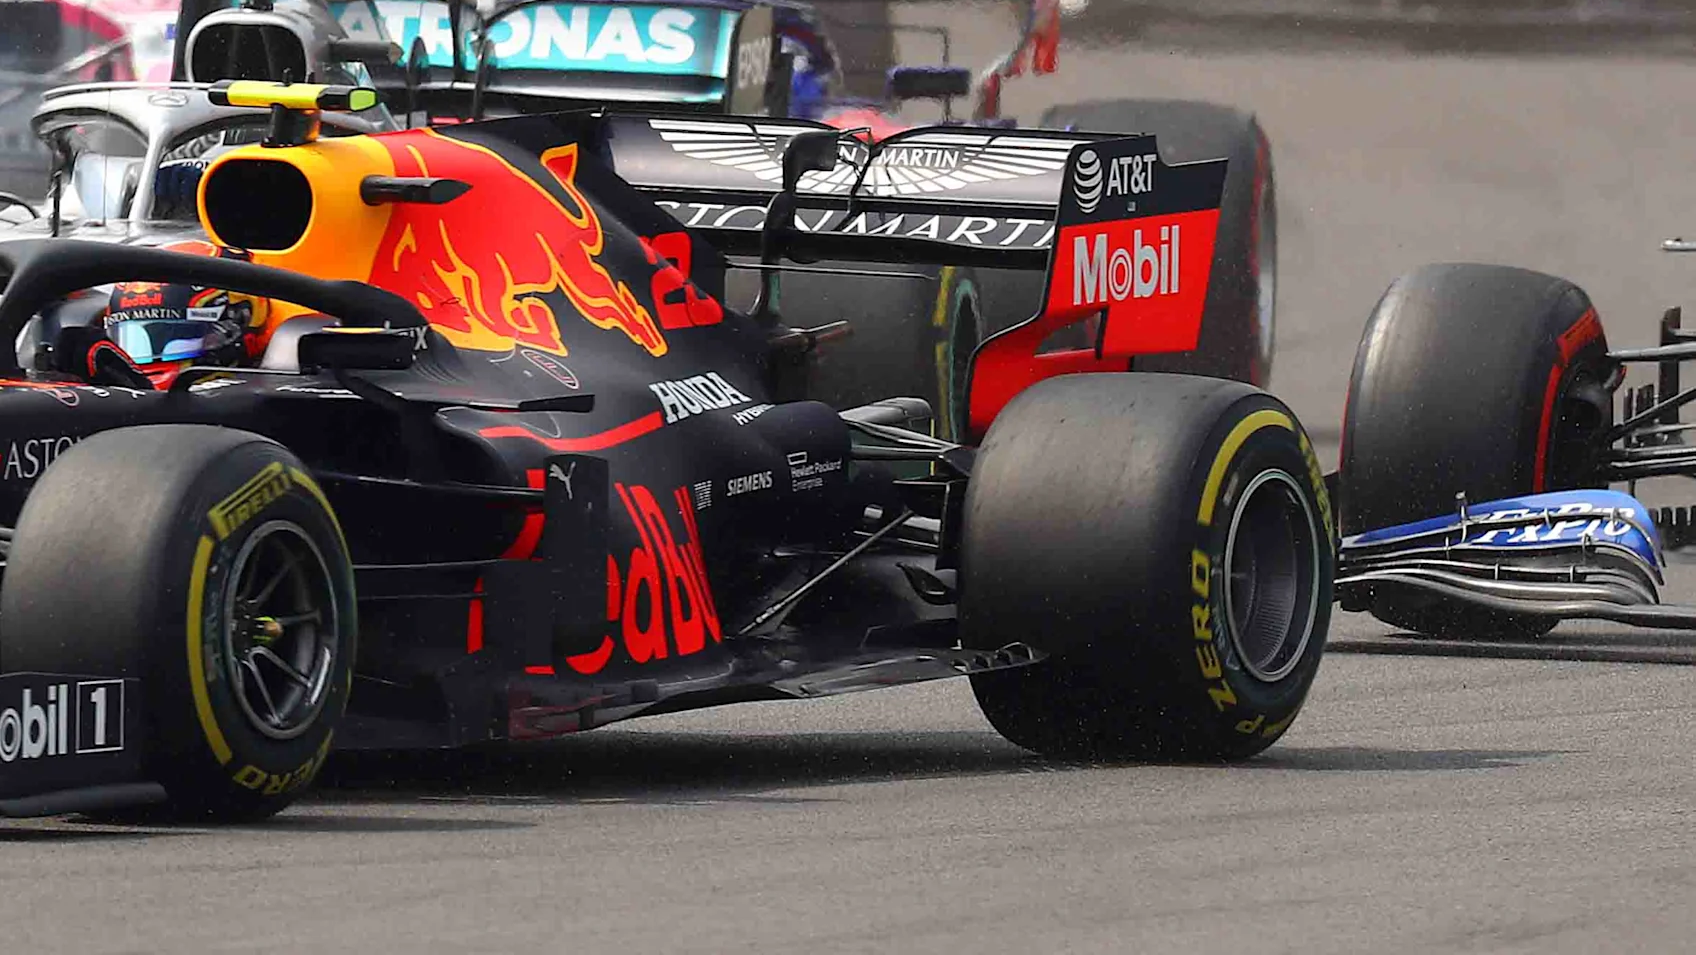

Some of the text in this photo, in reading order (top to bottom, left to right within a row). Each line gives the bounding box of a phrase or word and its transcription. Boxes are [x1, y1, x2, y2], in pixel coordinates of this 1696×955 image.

[876, 147, 960, 170] MARTIN
[1106, 153, 1157, 197] AT&T
[844, 204, 1056, 249] MARTI
[1073, 224, 1180, 306] Mobil
[132, 307, 181, 320] MARTIN
[649, 371, 753, 425] HONDA
[3, 435, 84, 480] ASTO
[207, 460, 294, 541] PIRELLI
[726, 470, 773, 497] SIEMENS
[1191, 549, 1238, 712] ZERO
[1234, 714, 1266, 735] P
